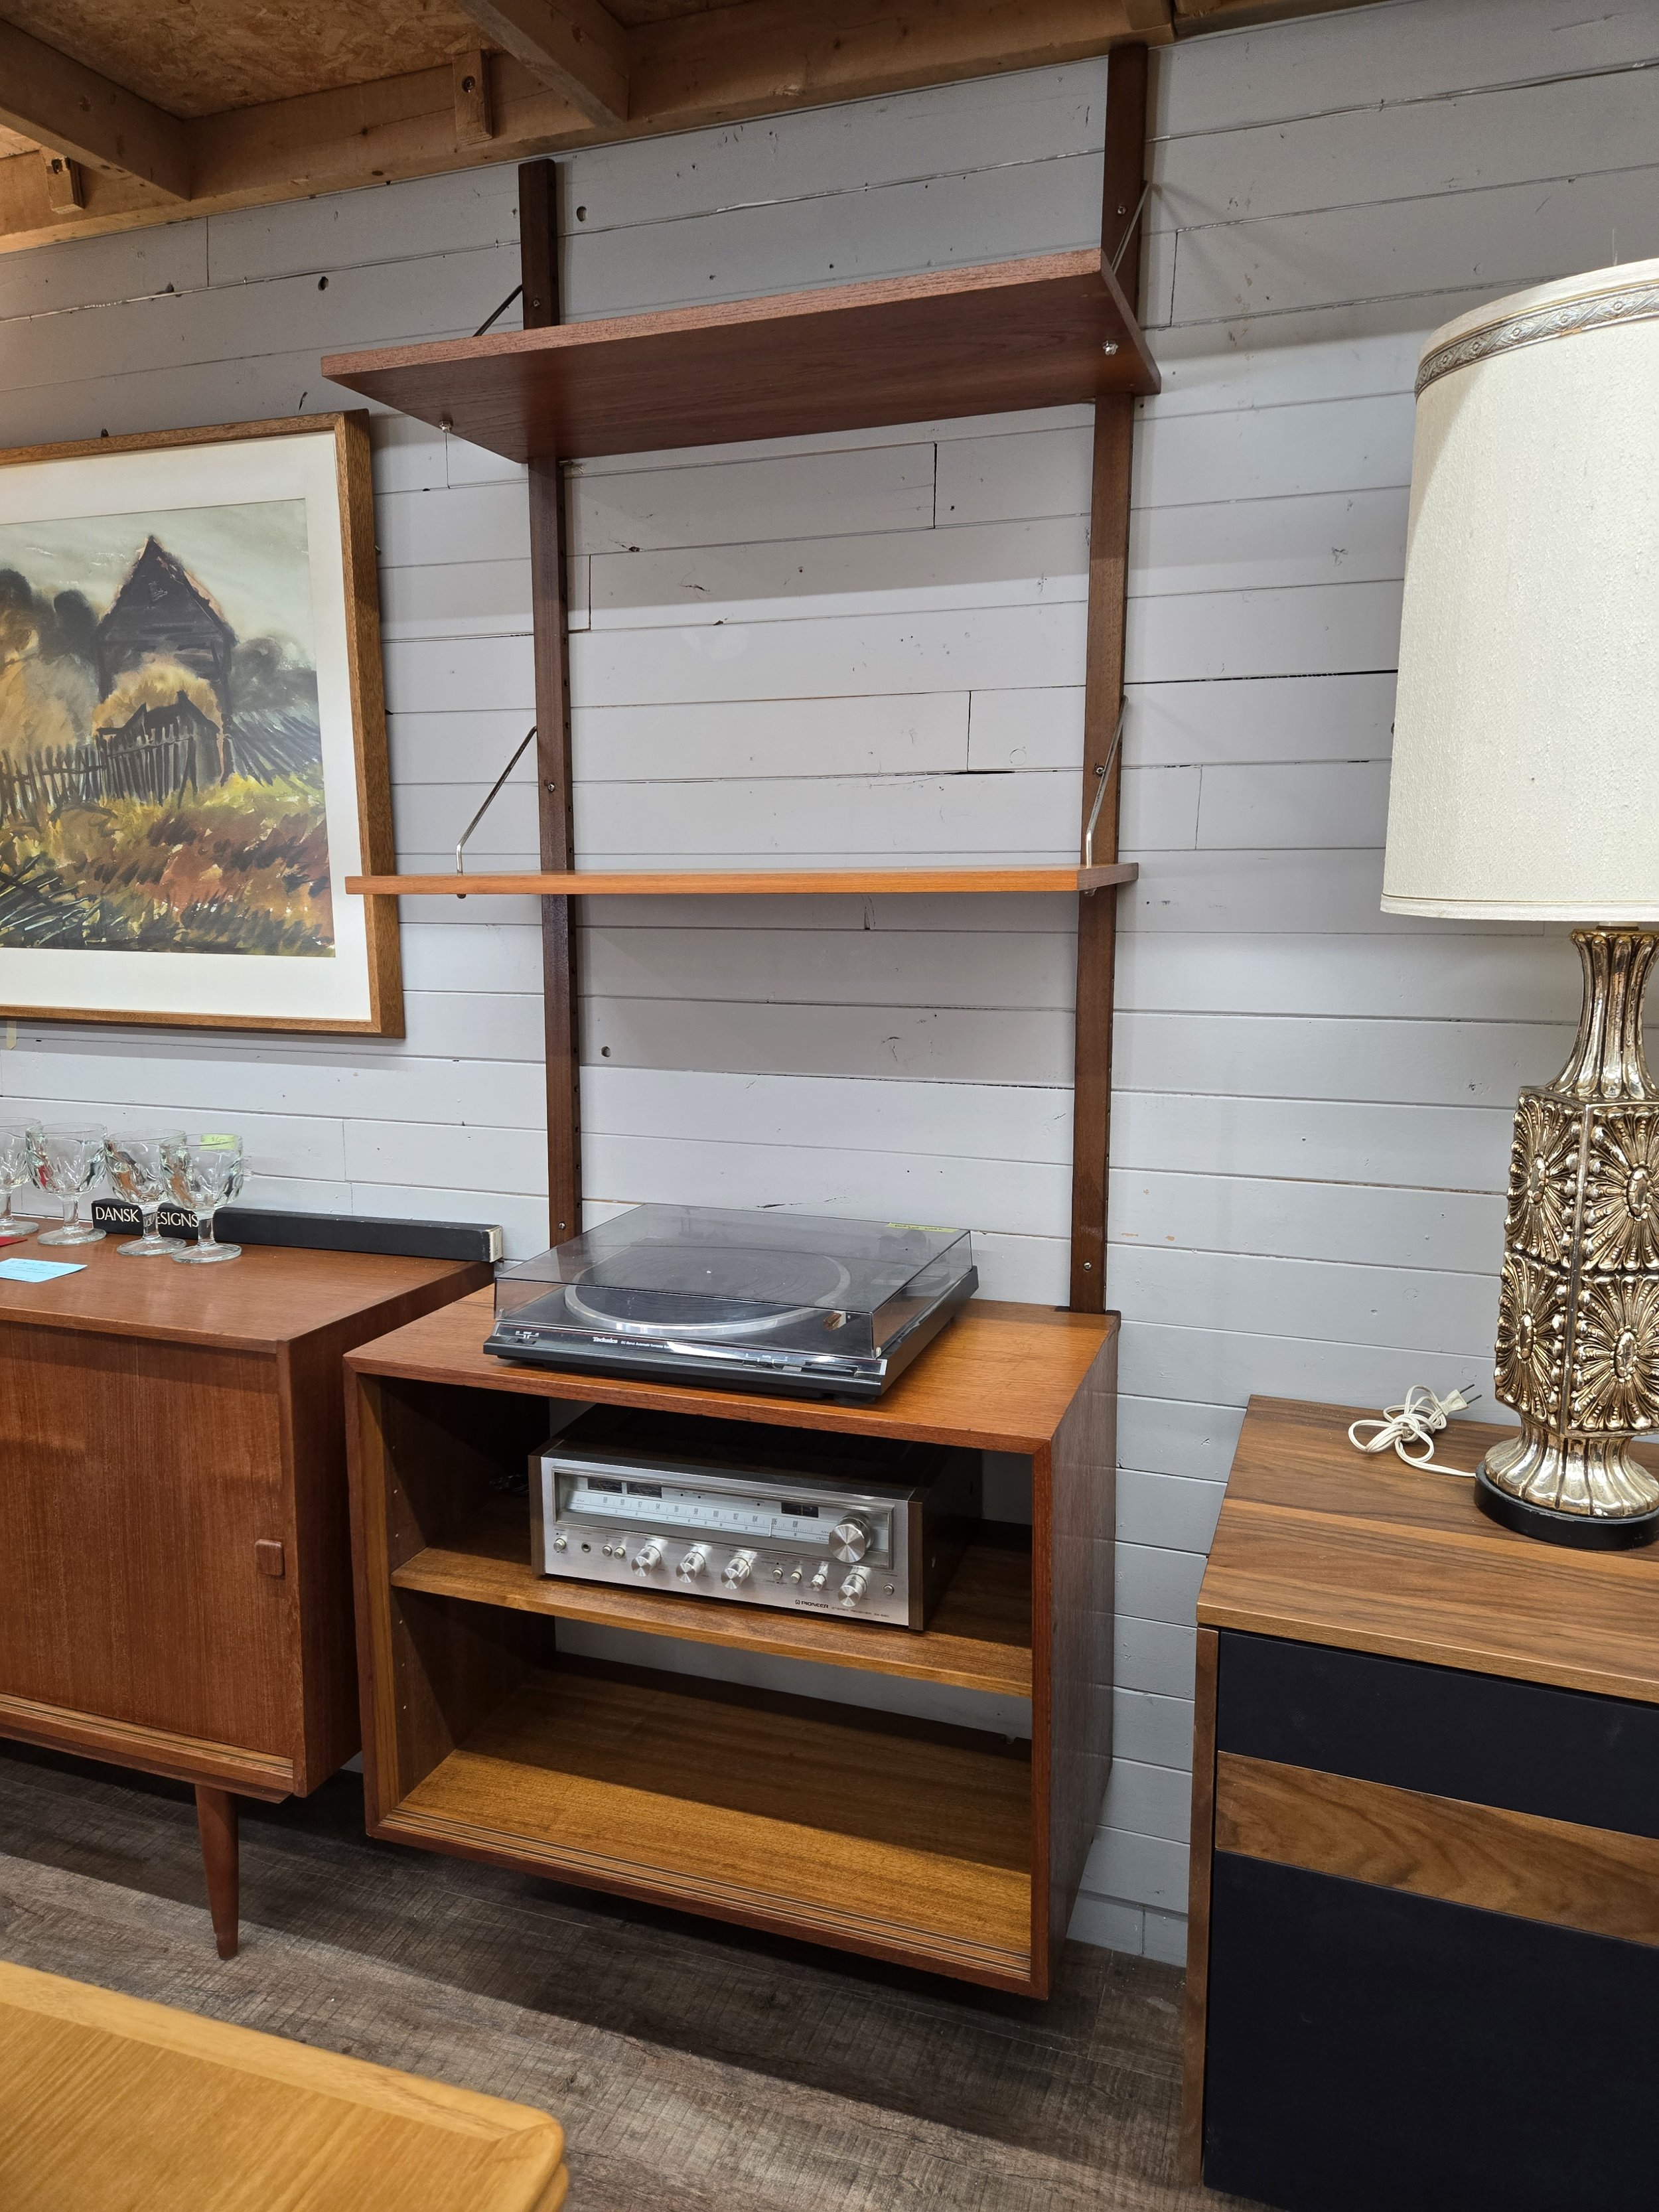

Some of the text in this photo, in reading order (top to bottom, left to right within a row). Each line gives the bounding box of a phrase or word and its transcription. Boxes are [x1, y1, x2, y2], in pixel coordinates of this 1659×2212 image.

[96, 1207, 199, 1228] DANSK ESIGNS
[802, 1600, 829, 1609] PIONEER
